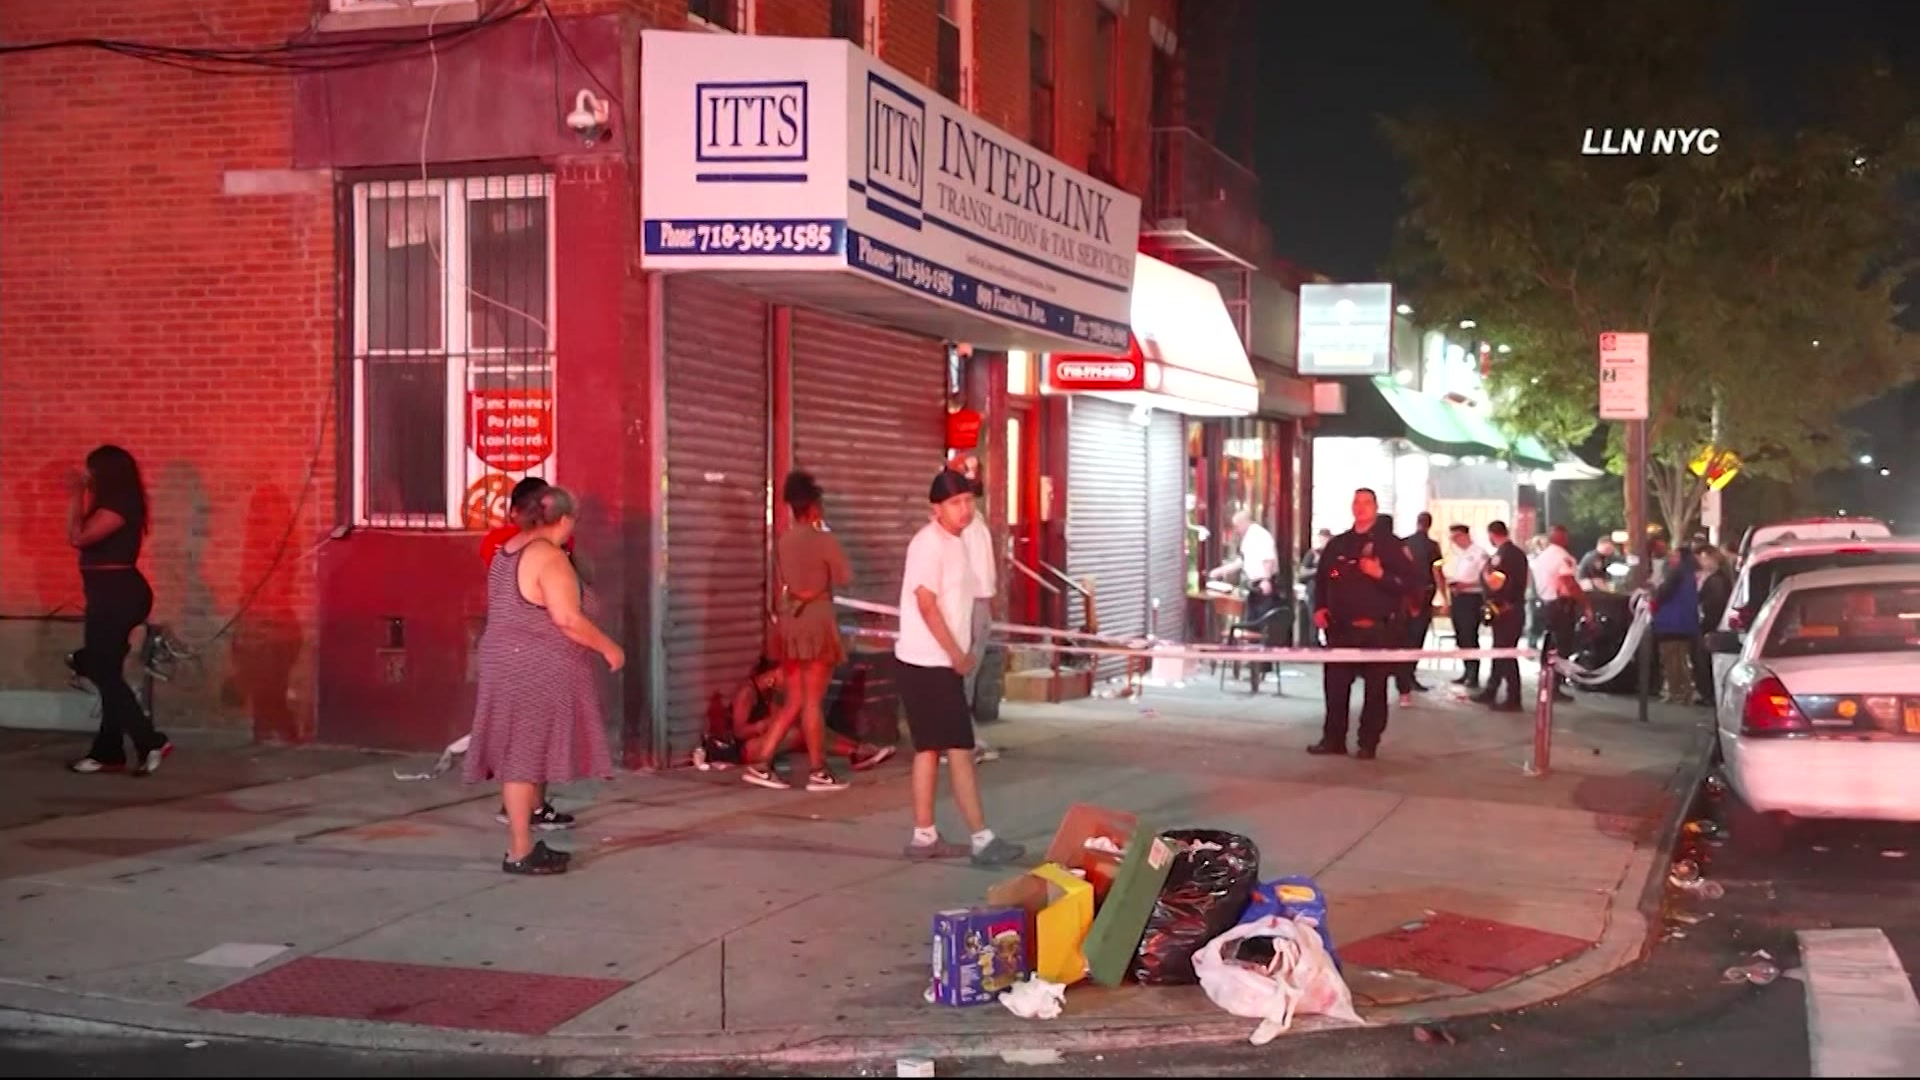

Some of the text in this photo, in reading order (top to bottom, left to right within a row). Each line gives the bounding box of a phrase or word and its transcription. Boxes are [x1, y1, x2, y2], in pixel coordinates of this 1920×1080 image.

[708, 93, 798, 147] ITTS
[874, 97, 920, 188] ITTS
[938, 113, 1113, 244] INTERLINK
[697, 223, 831, 252] 718-363-1585
[936, 182, 1038, 246] TRANSLATION
[1039, 228, 1049, 253] &
[1052, 233, 1075, 262] TAX
[1076, 242, 1130, 279] SERVICES
